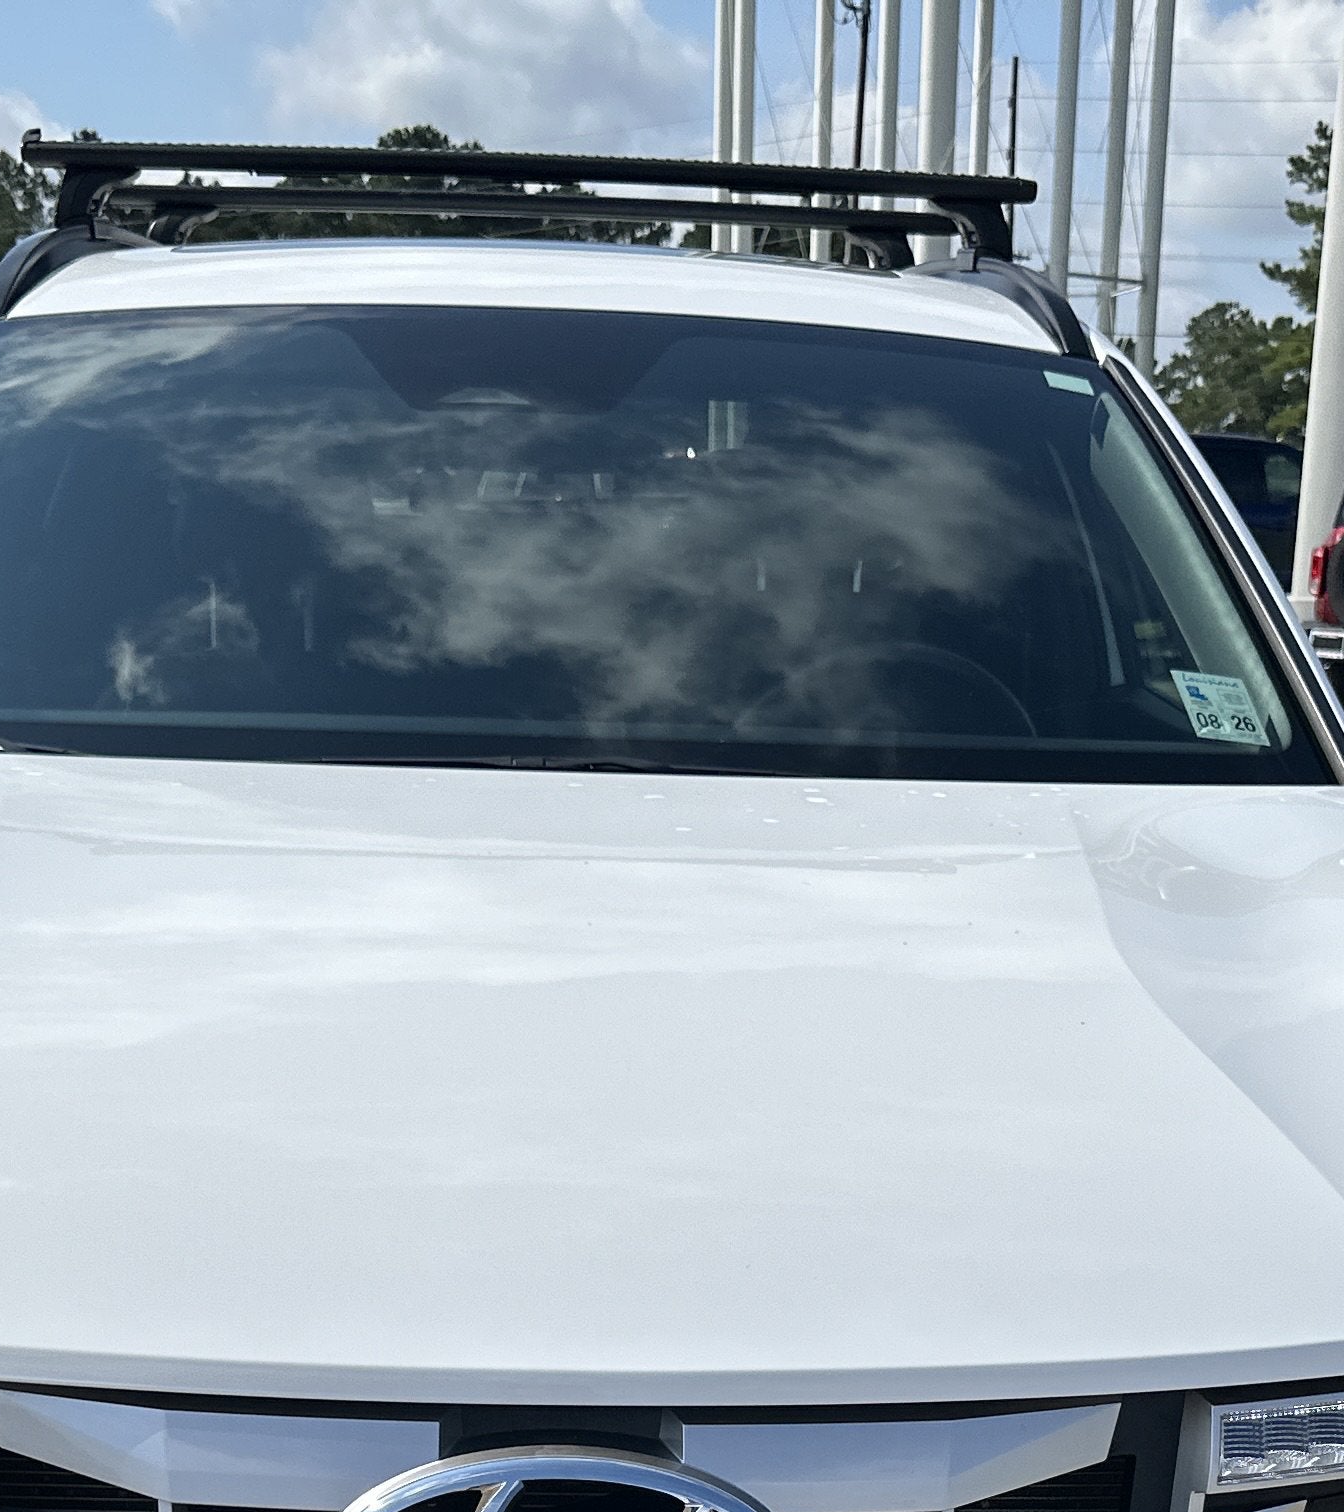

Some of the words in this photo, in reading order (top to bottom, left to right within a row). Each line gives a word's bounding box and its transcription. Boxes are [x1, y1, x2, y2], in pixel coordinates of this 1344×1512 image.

[1181, 672, 1240, 689] Louisiana
[1196, 711, 1222, 730] 08
[1230, 713, 1256, 733] 26
